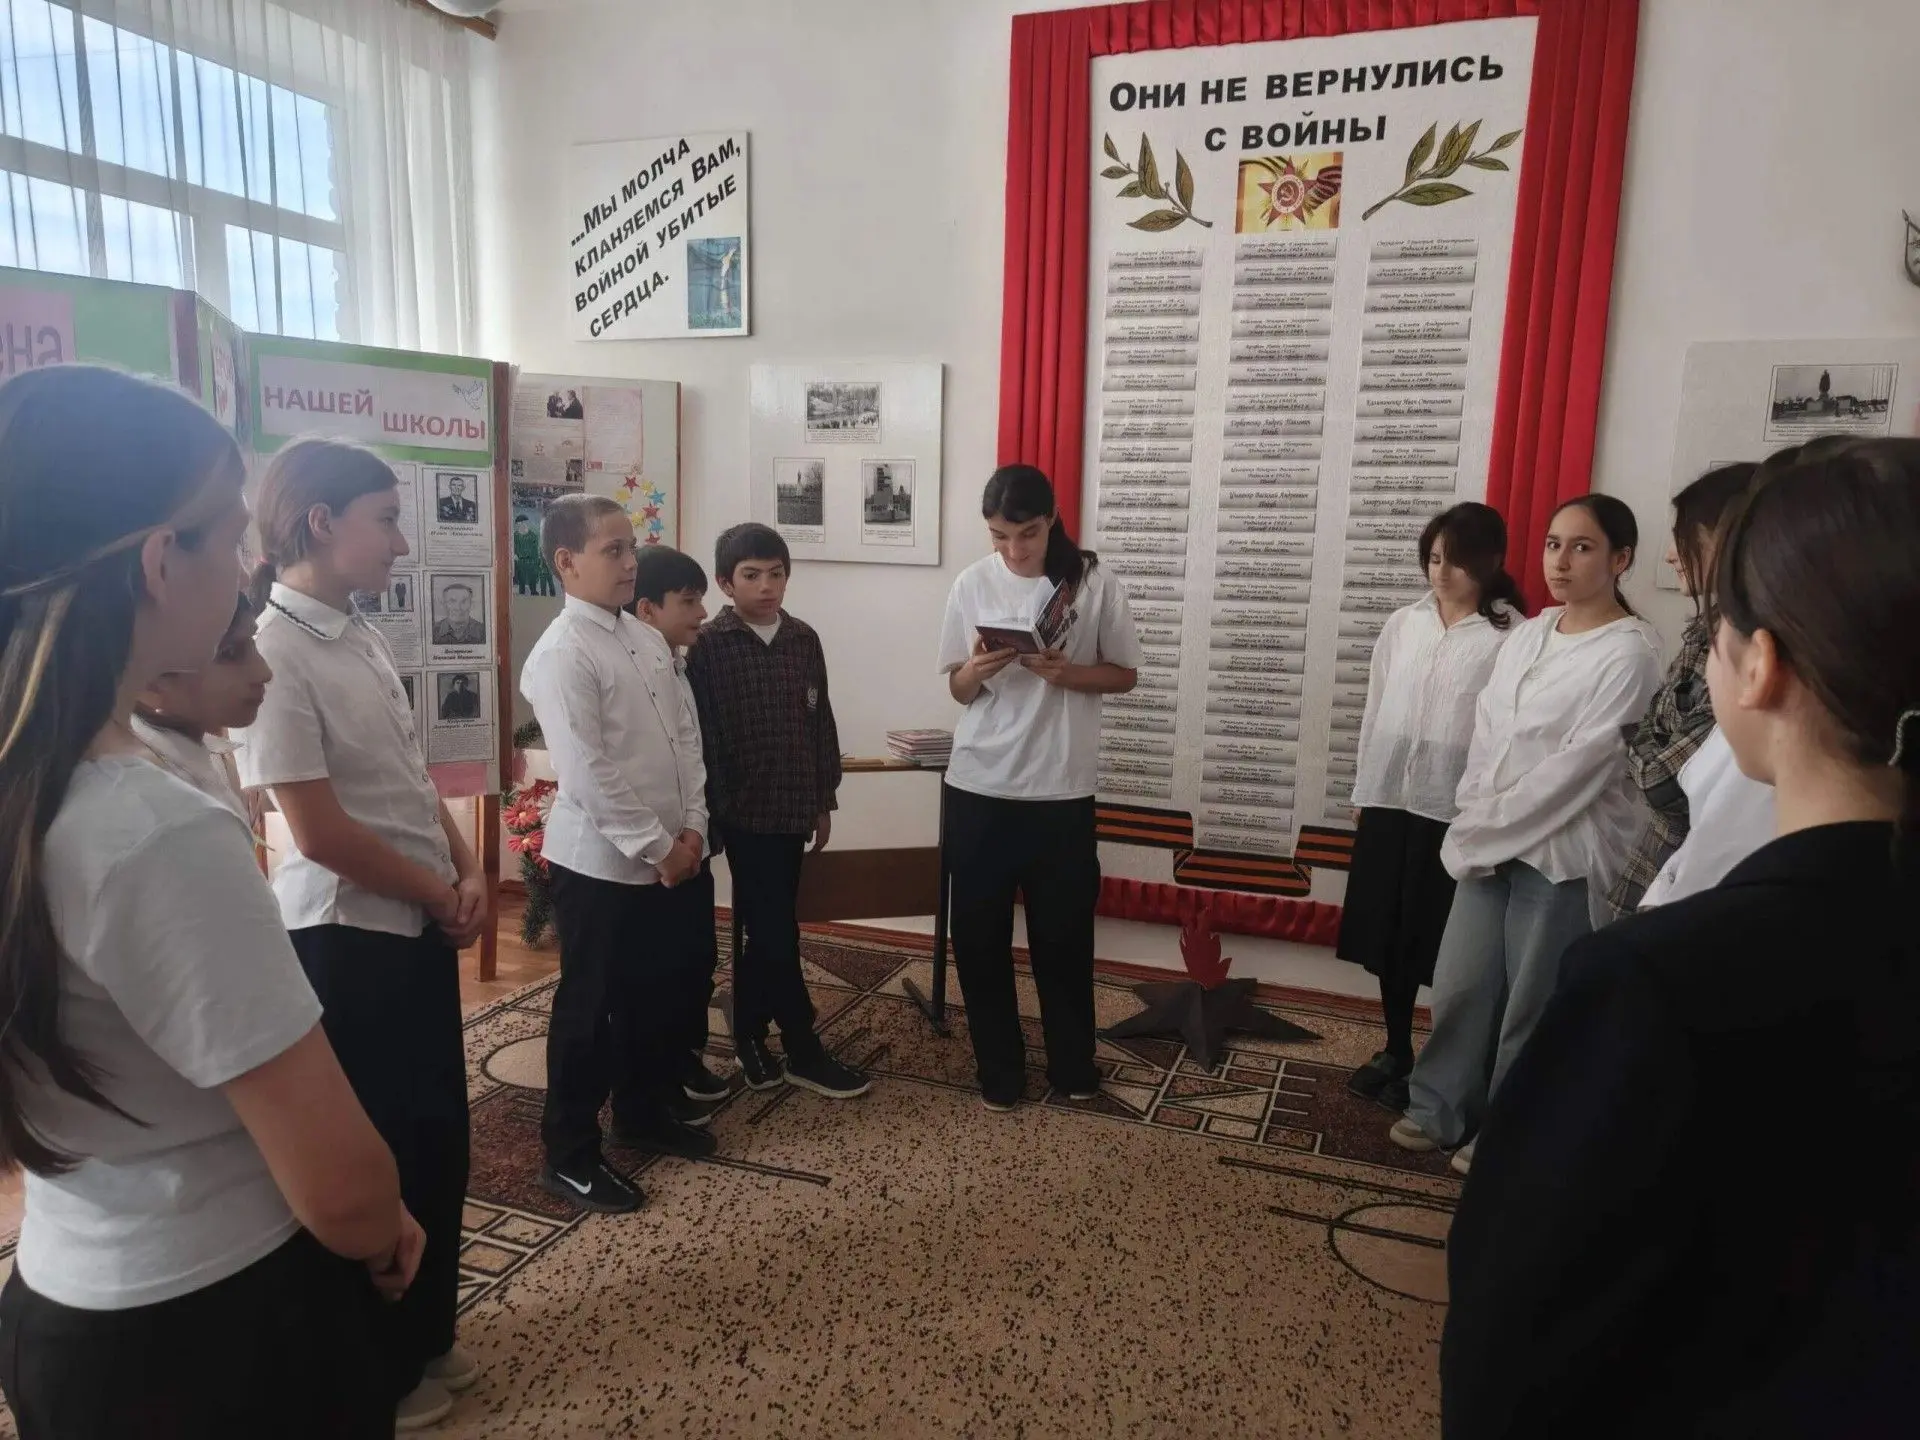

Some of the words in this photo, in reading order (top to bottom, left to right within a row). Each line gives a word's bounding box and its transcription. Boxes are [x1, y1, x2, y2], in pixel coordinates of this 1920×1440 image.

[1200, 77, 1247, 104] НЕ
[1265, 54, 1504, 100] ВЕРНУЛИСЬ
[1204, 127, 1226, 152] С
[1241, 110, 1387, 150] ВОЙНЫ
[622, 138, 690, 203] МОЛЧА
[575, 178, 684, 277] КЛАНЯЕМСЯ
[575, 239, 650, 312] ВОЙНОЙ
[656, 174, 737, 248] УБИТЫЕ
[264, 385, 374, 417] НАШЕЙ
[383, 411, 486, 440] ШКОЛЫ
